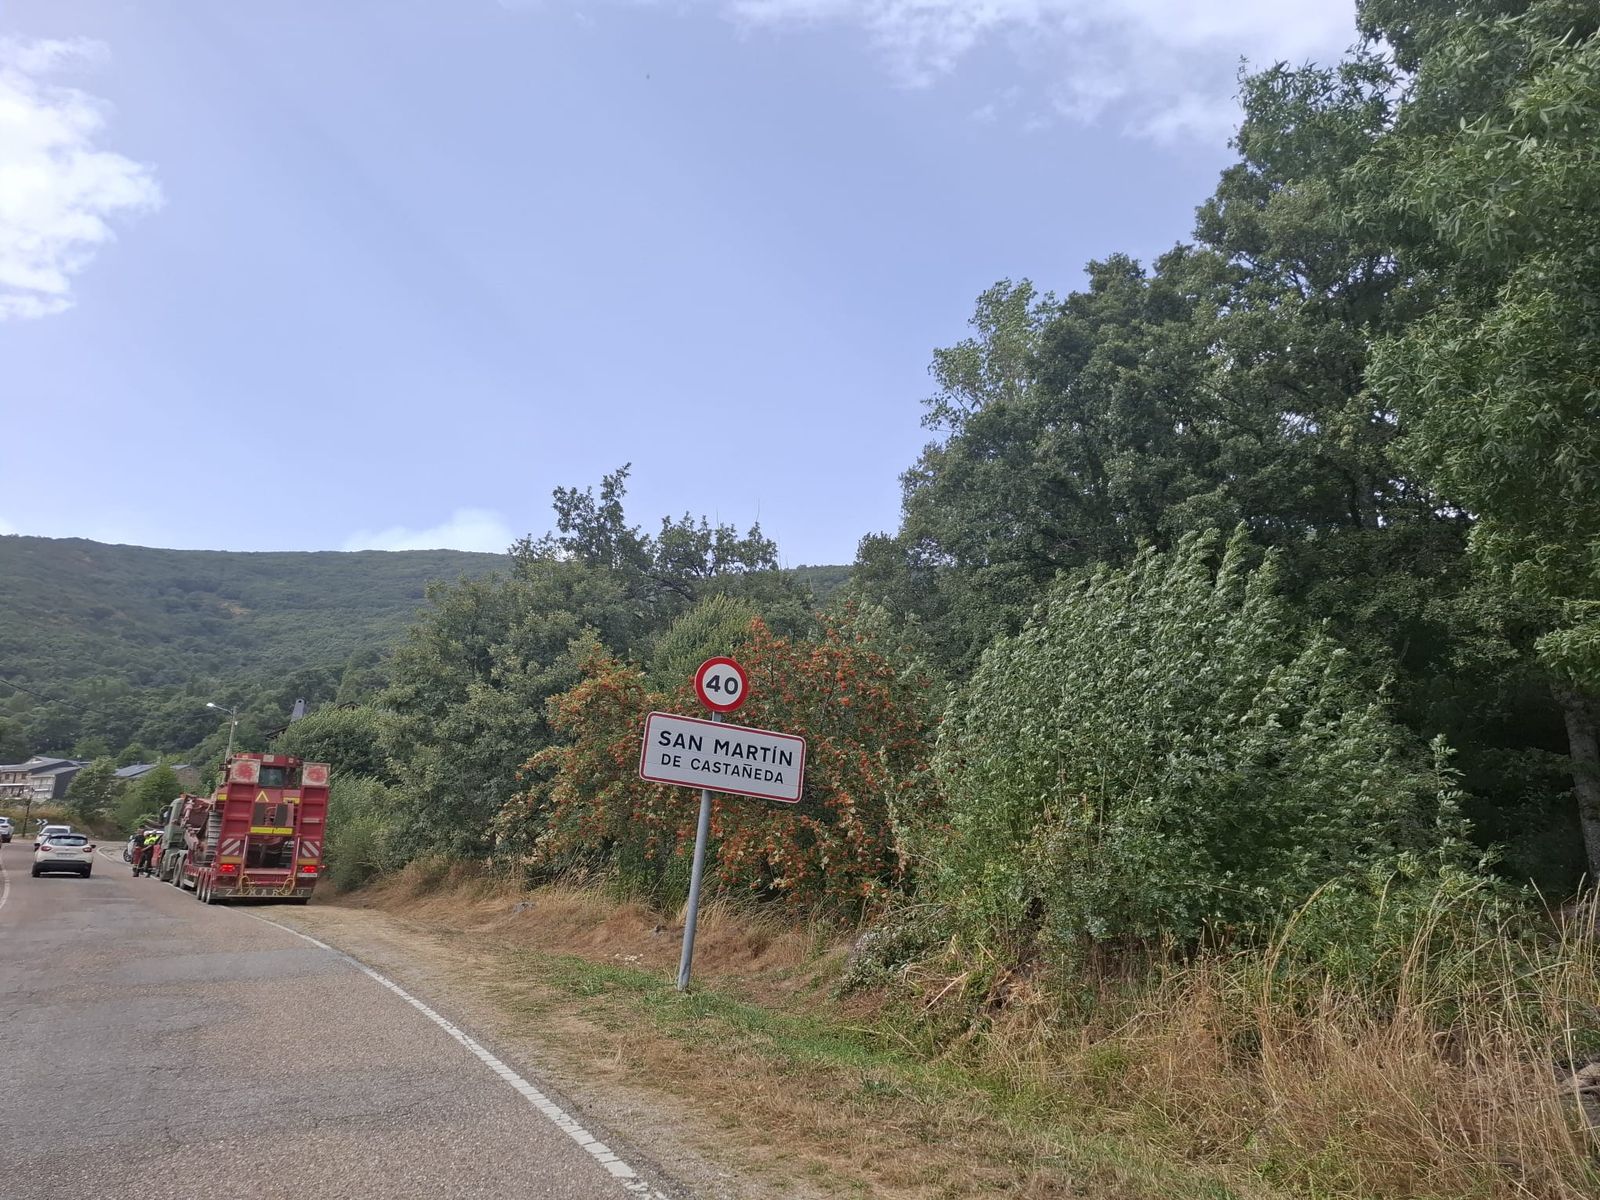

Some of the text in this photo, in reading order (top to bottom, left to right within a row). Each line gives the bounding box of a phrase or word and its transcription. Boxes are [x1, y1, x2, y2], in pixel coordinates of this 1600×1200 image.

[706, 675, 739, 696] 40
[658, 731, 792, 766] SAN MARTÍN
[660, 754, 784, 784] DE CASTAÑEDA
